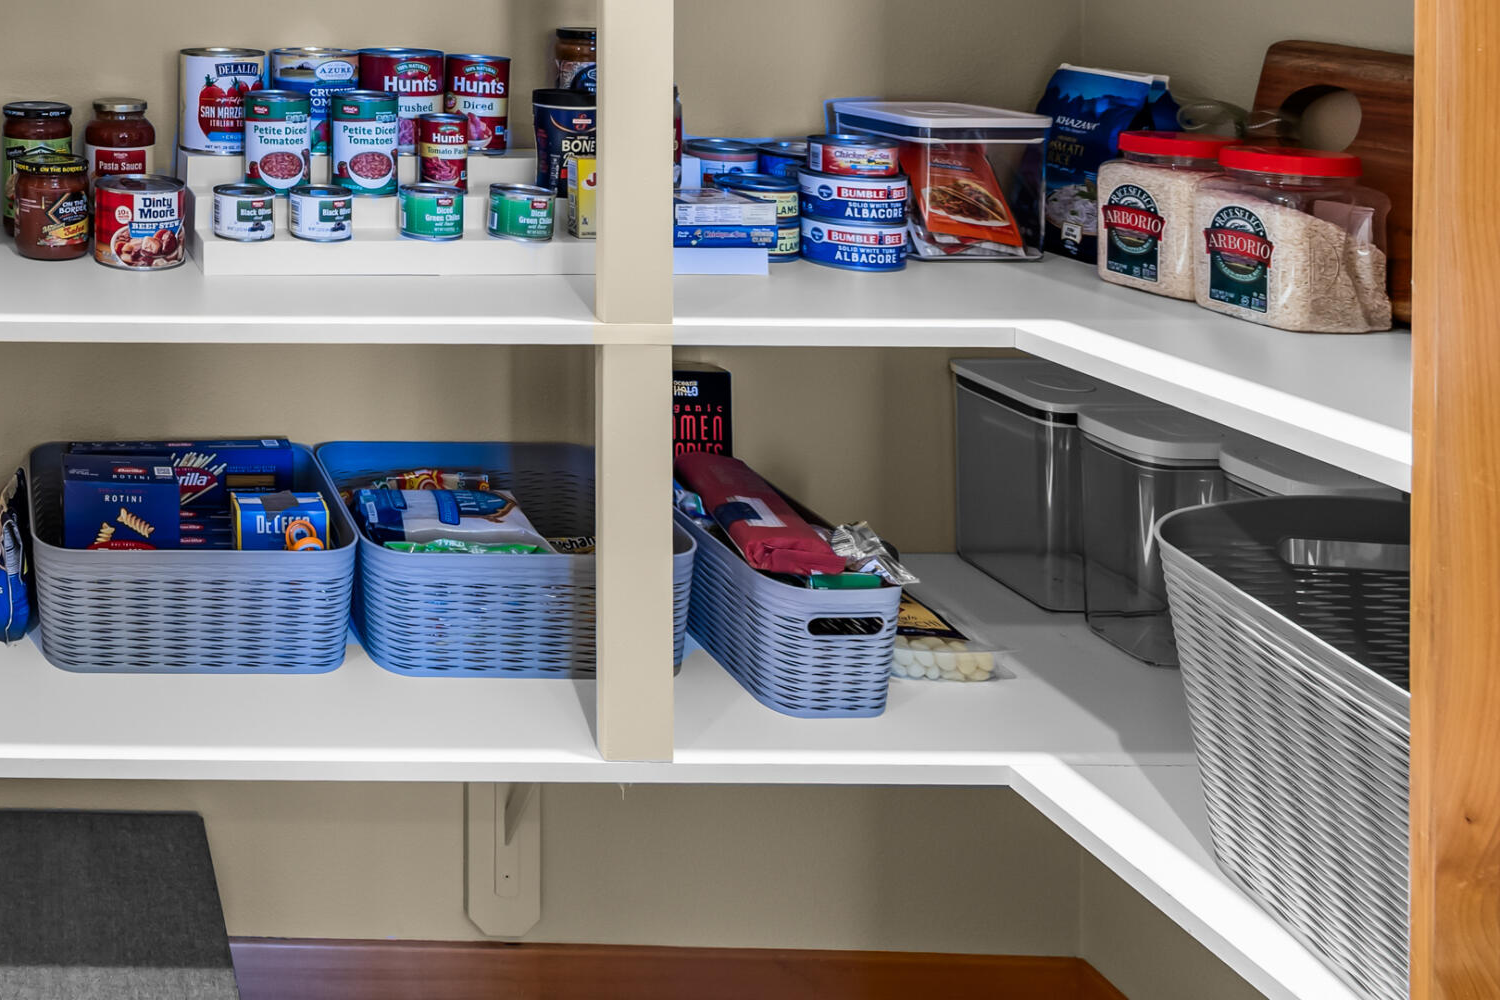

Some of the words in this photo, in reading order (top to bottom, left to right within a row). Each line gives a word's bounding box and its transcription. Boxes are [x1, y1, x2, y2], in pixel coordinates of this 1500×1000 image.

[217, 64, 257, 76] DELALLO
[320, 67, 351, 75] AZURE
[383, 75, 438, 93] Hunt's
[453, 76, 505, 94] Hunt's
[463, 101, 495, 111] Diced
[200, 106, 216, 119] SAN
[253, 125, 283, 135] Petite
[284, 125, 308, 136] Diced
[343, 125, 373, 135] Petite
[374, 125, 397, 136] Diced
[258, 135, 304, 146] Tomatoes
[348, 135, 393, 146] Tomatoes
[432, 132, 465, 144] Hunt's
[561, 138, 596, 153] BONE
[99, 161, 119, 172] Pasta
[120, 161, 143, 171] Sauce
[840, 187, 886, 199] BUMBLE
[892, 187, 906, 198] BEE
[59, 204, 88, 214] BORDER
[141, 197, 173, 210] Dinty
[139, 208, 176, 220] Moore
[844, 207, 903, 219] ALBACORE
[131, 221, 158, 231] BEEF
[158, 220, 181, 230] STEW
[1104, 208, 1163, 234] ARBORIO
[831, 231, 877, 244] BUMBLE
[885, 234, 901, 245] BEE
[1208, 231, 1273, 259] ARBORIO
[835, 250, 898, 264] ALBACORE
[104, 494, 143, 504] ROTINI
